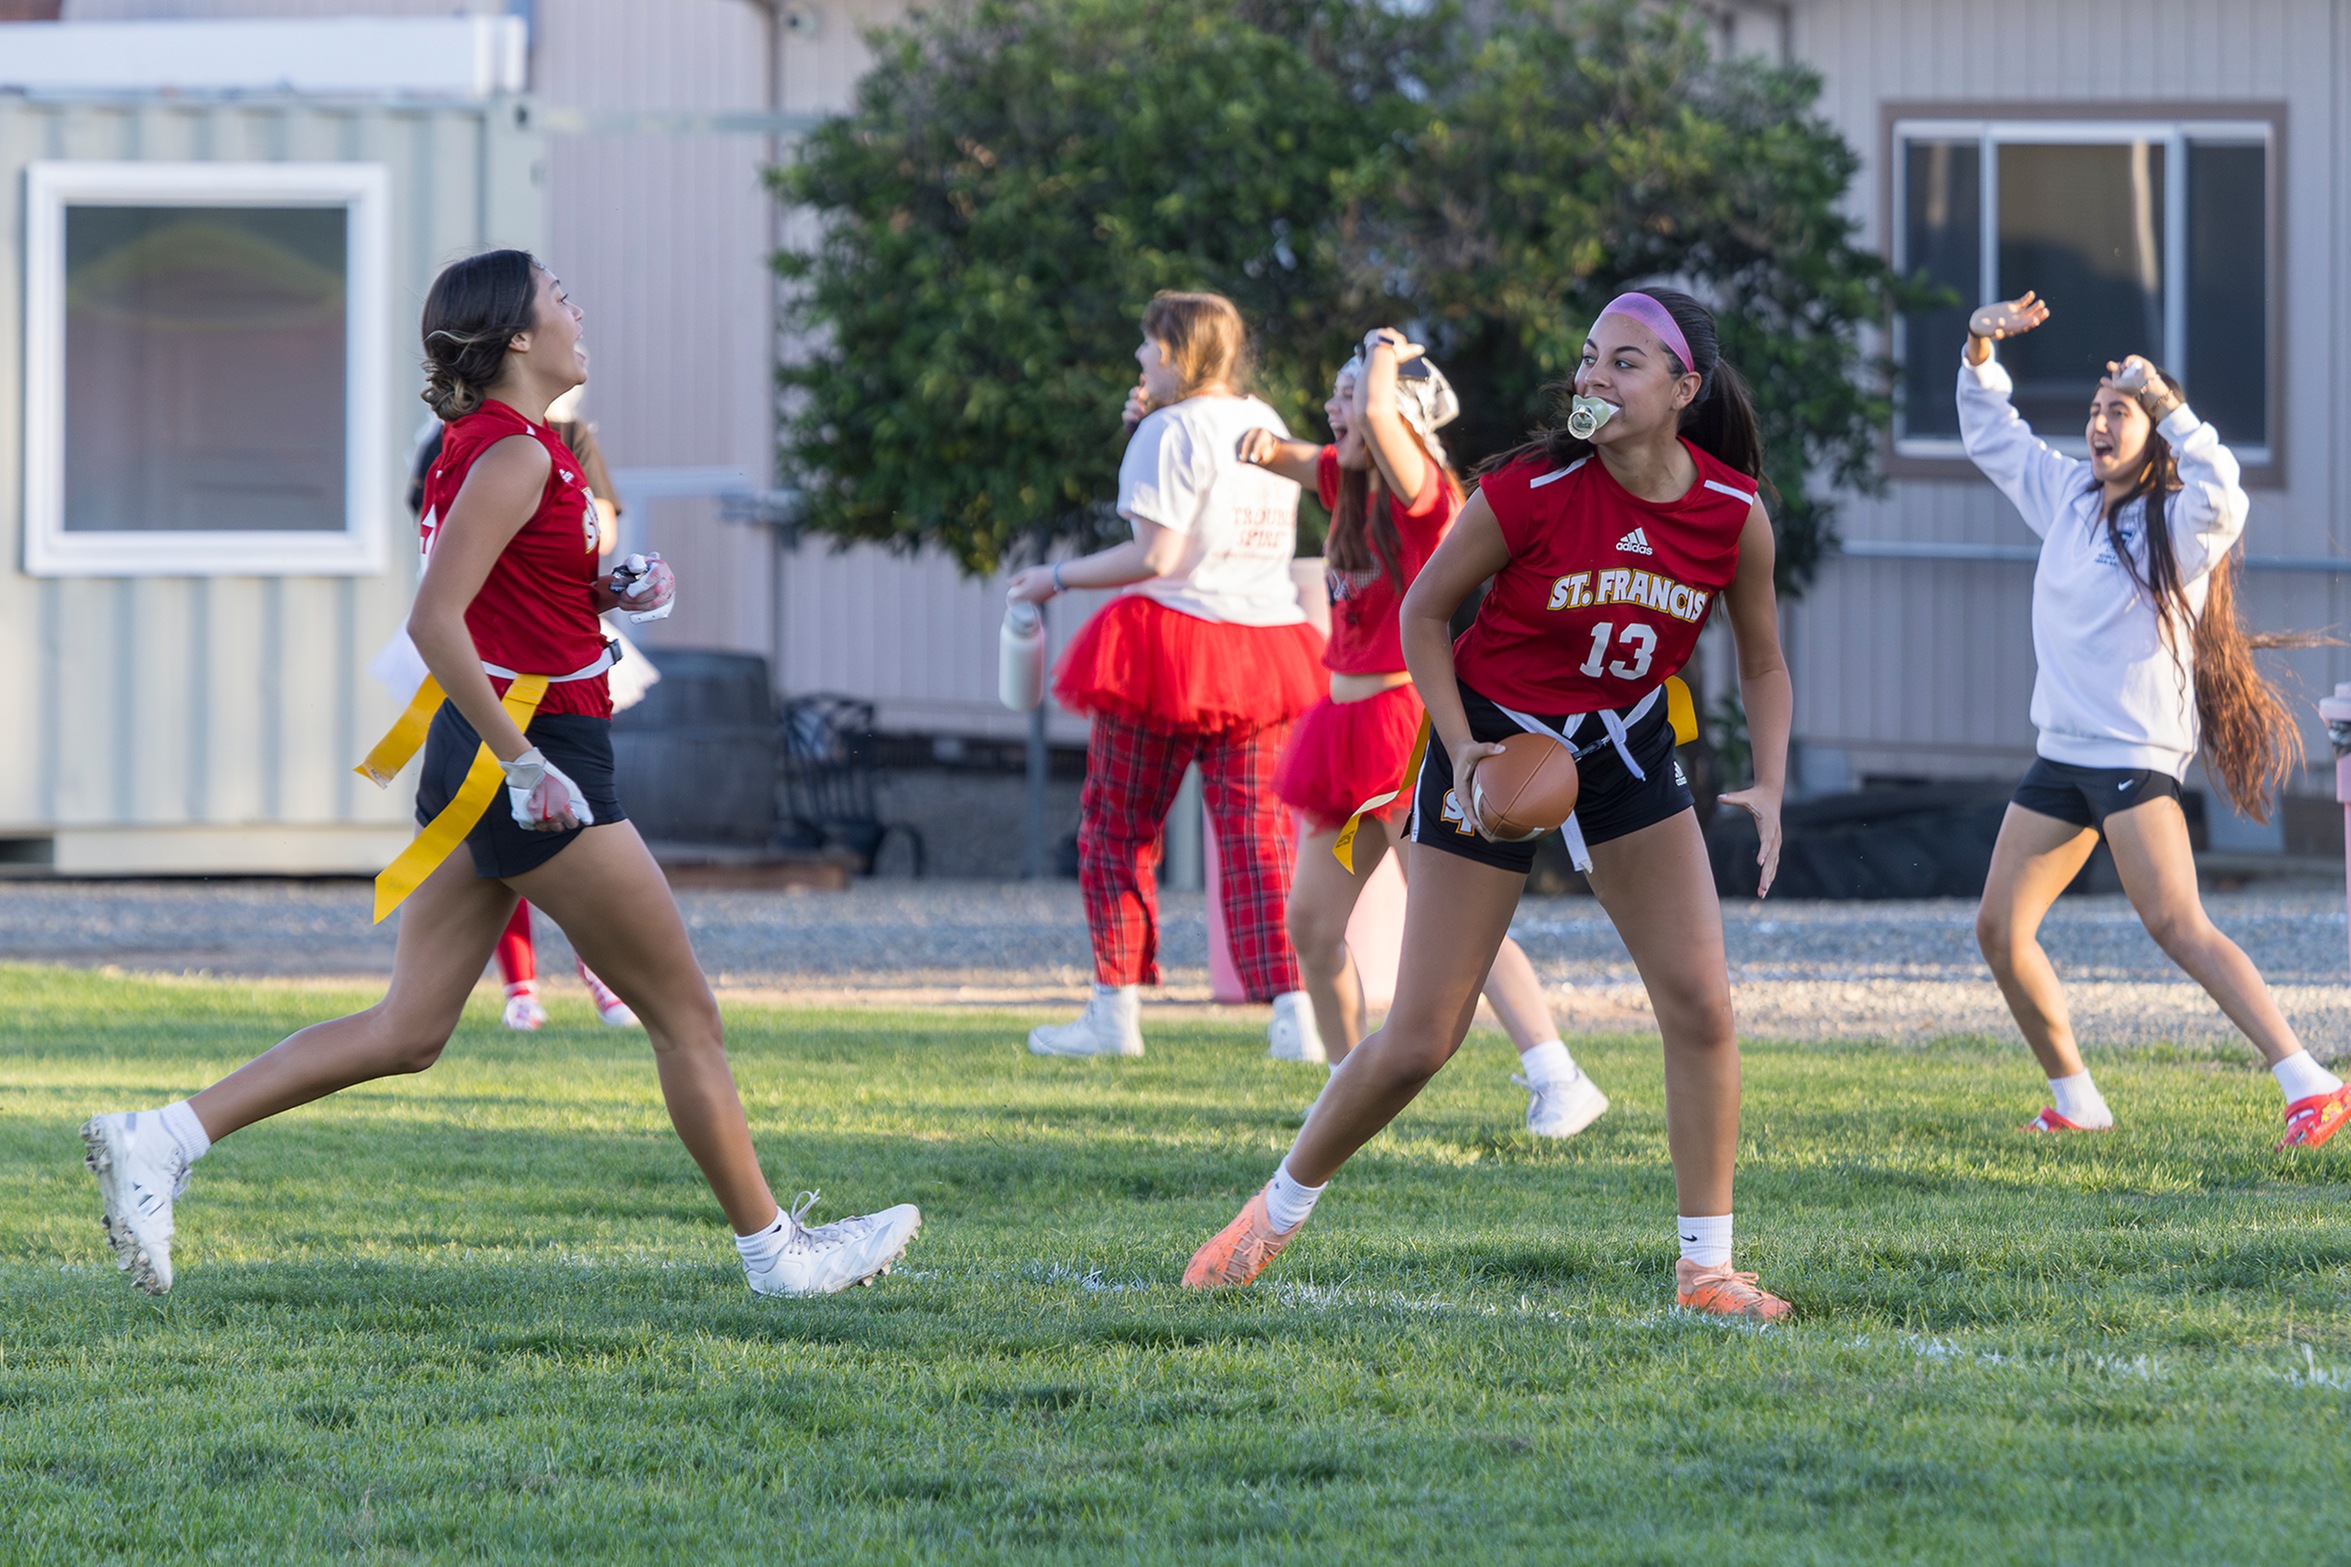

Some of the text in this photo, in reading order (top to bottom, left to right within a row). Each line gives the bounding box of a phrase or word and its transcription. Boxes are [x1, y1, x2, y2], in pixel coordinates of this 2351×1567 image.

[1615, 541, 1653, 556] adidas
[1547, 567, 1708, 623] ST. FRANCIS
[1579, 622, 1657, 680] 13
